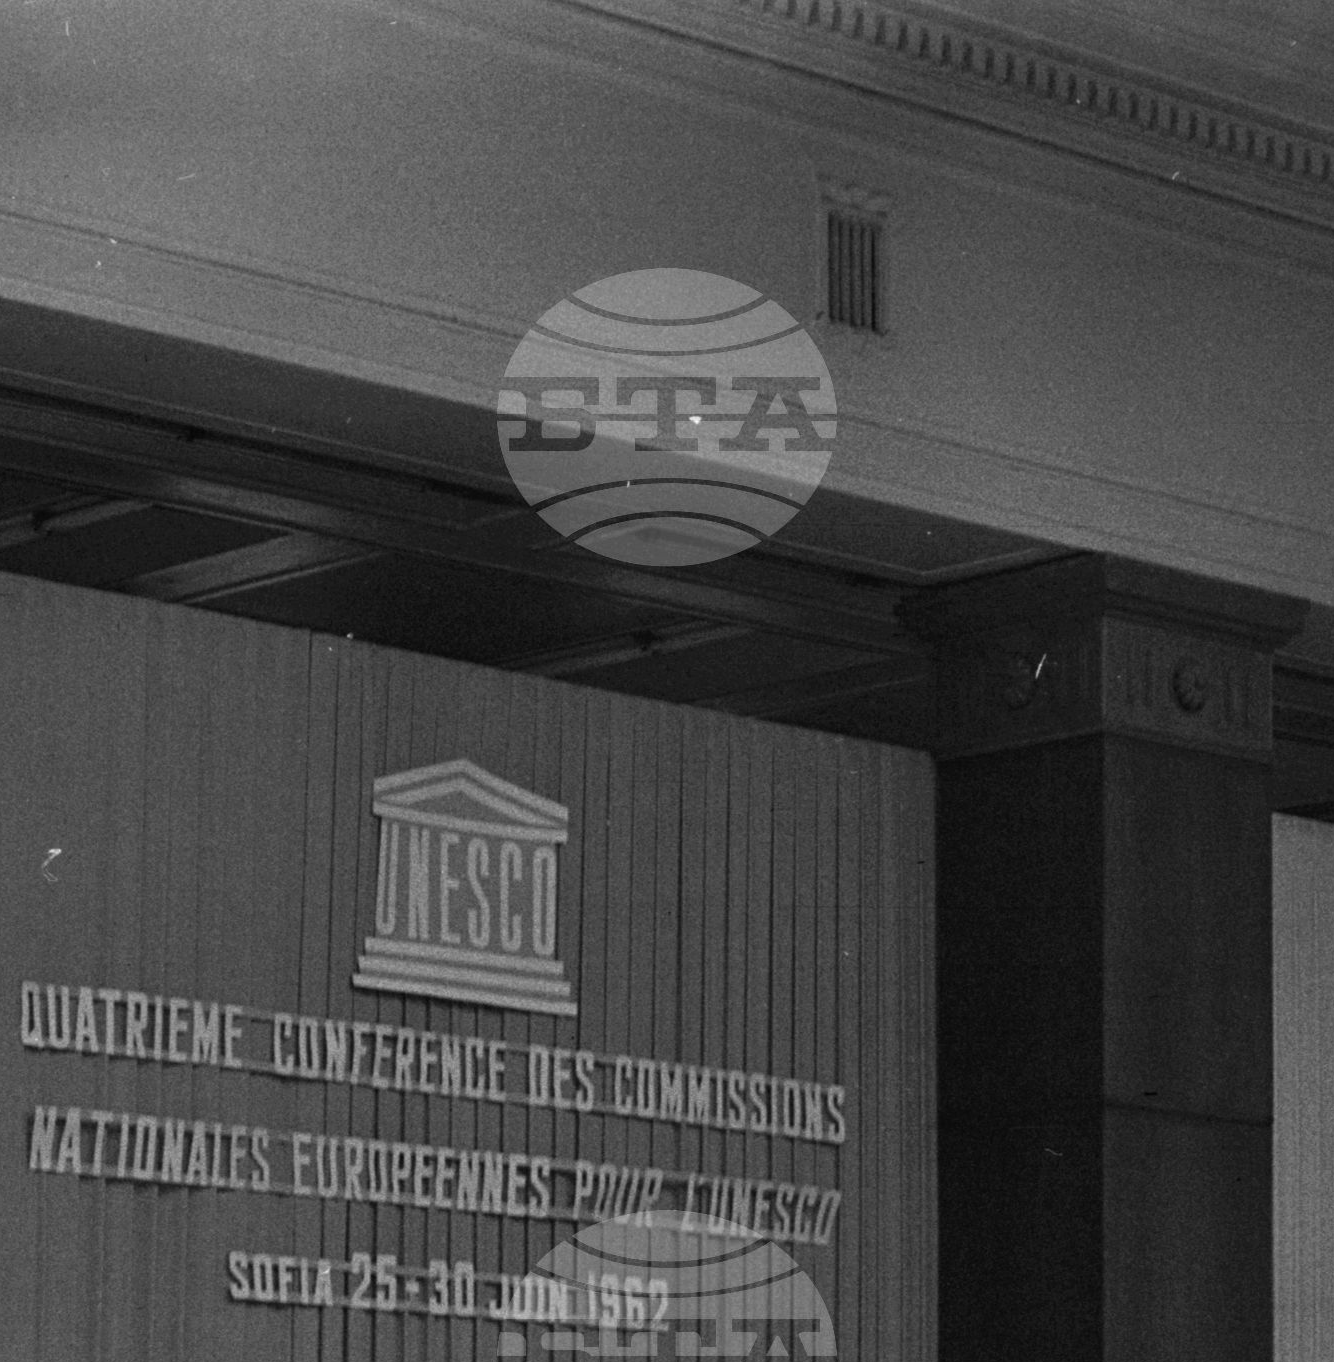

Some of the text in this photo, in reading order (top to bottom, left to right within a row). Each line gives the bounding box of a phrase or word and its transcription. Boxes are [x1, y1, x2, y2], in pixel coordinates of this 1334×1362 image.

[376, 816, 557, 957] UNESCO
[21, 980, 846, 1144] QUATRIEME CONFERENCE DES COMMISSIONS
[28, 1104, 269, 1192] NATIONALES
[292, 1131, 551, 1218] EUROPEENNES
[573, 1159, 664, 1228] POUR
[228, 1250, 334, 1305] SOFIA
[489, 1273, 569, 1322] JUIN
